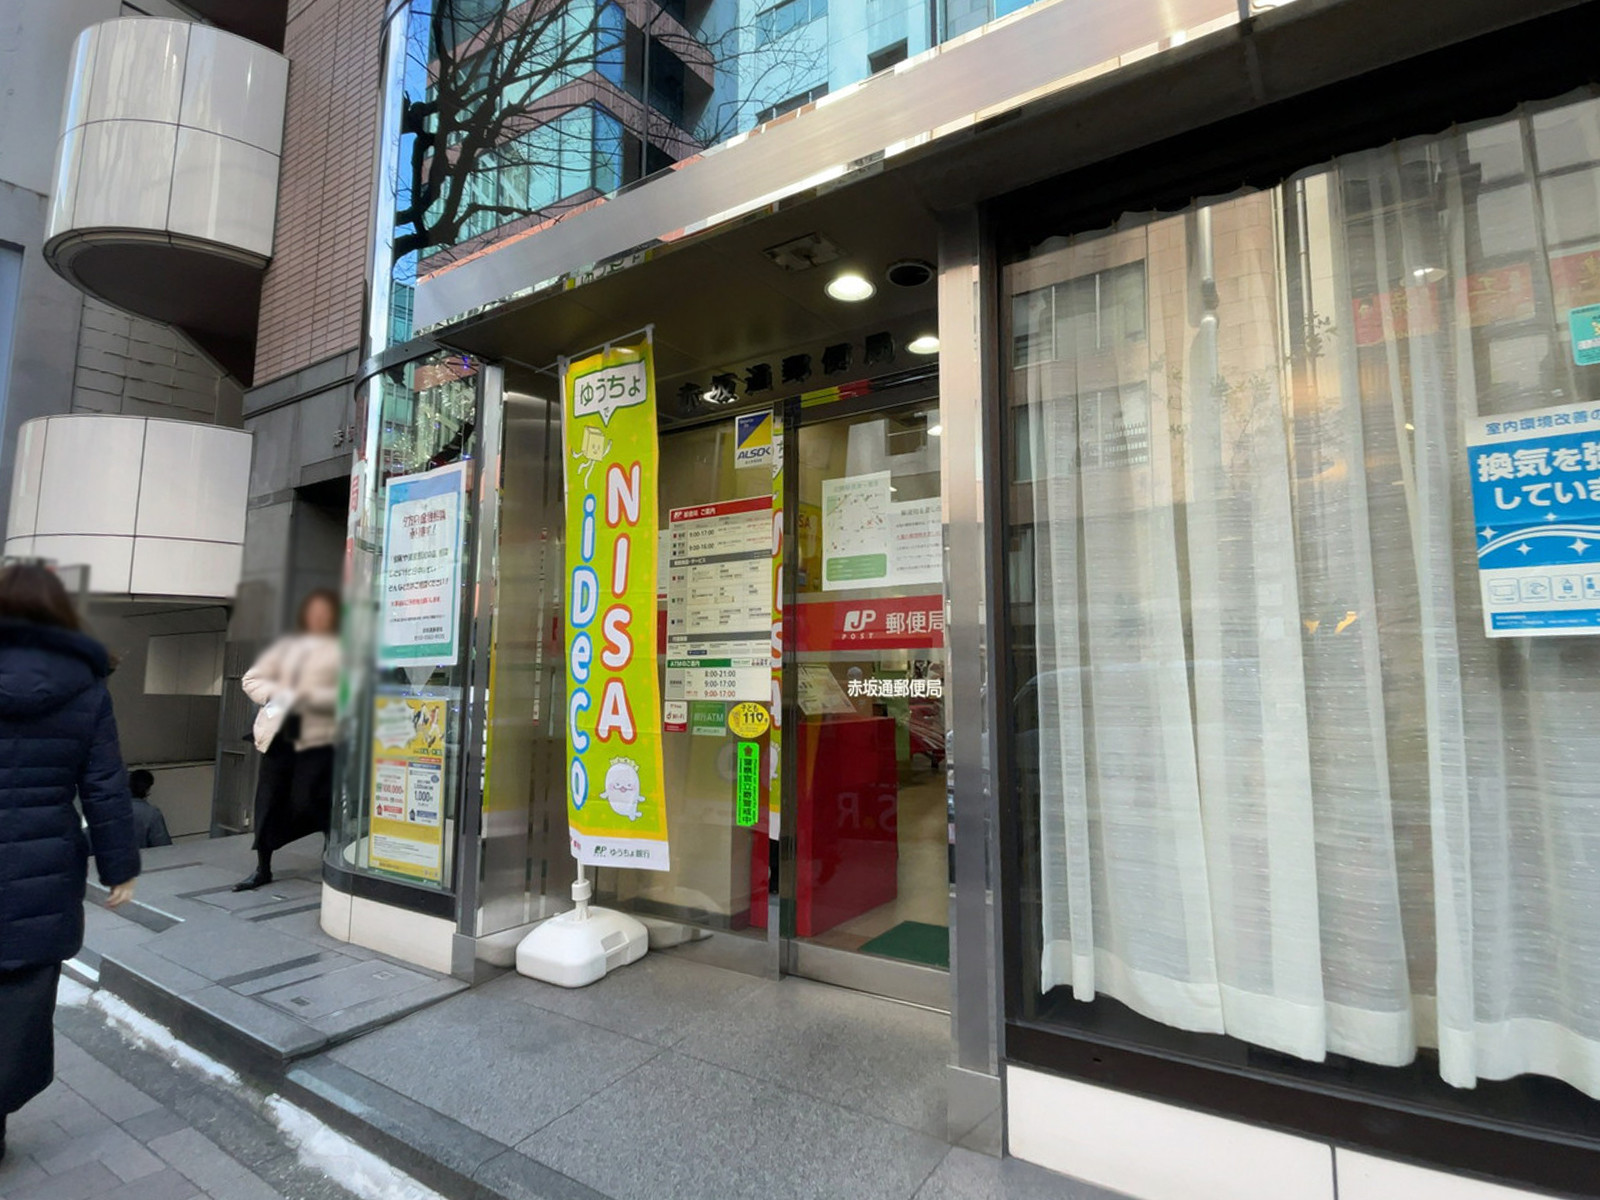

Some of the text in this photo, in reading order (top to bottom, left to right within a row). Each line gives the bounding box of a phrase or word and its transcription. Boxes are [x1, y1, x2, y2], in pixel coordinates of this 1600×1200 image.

[580, 374, 641, 407] ゆうちょ
[1485, 409, 1600, 436] 室内環境改善の
[737, 446, 771, 460] ALSOK
[595, 460, 642, 745] NISA
[886, 609, 945, 635] 郵便局
[841, 632, 875, 641] POST
[569, 493, 599, 810] iDeCo
[704, 680, 736, 688] 9:00-17:00
[705, 670, 736, 678] 8:00-21:00
[704, 690, 736, 698] 9:00-17:00
[847, 677, 942, 698] 赤坂通郵便局
